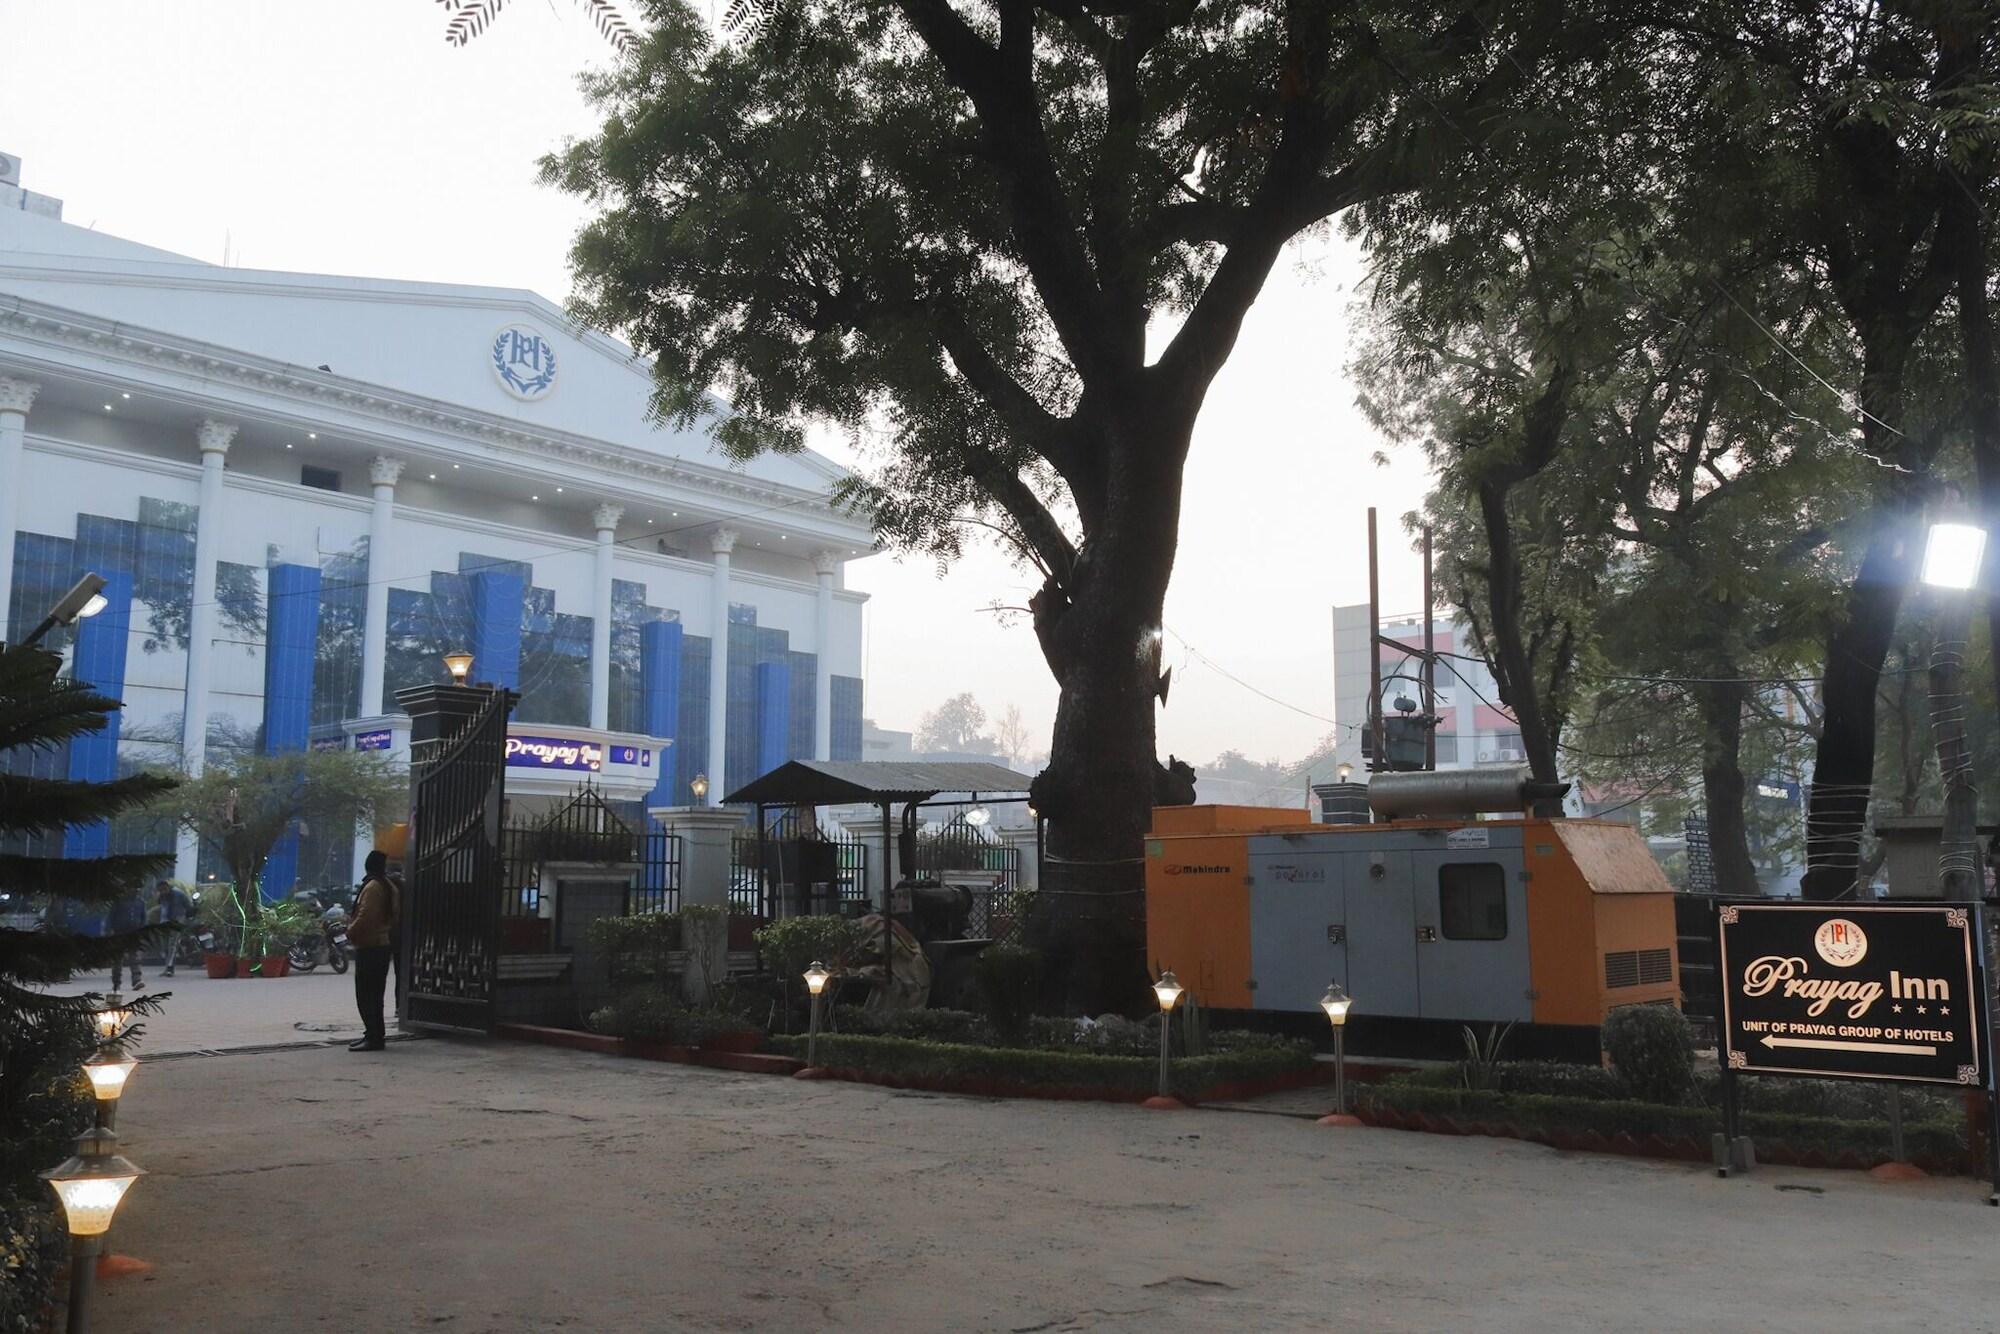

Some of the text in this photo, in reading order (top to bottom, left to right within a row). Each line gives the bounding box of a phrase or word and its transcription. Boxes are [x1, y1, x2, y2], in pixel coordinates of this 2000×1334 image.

[505, 738, 579, 765] Prayag
[1183, 864, 1231, 874] Mahindra
[1743, 956, 1950, 1019] Prayag Inn
[1742, 1021, 1954, 1042] UNIT OF PRAYAG GROUP OF HOTELS
